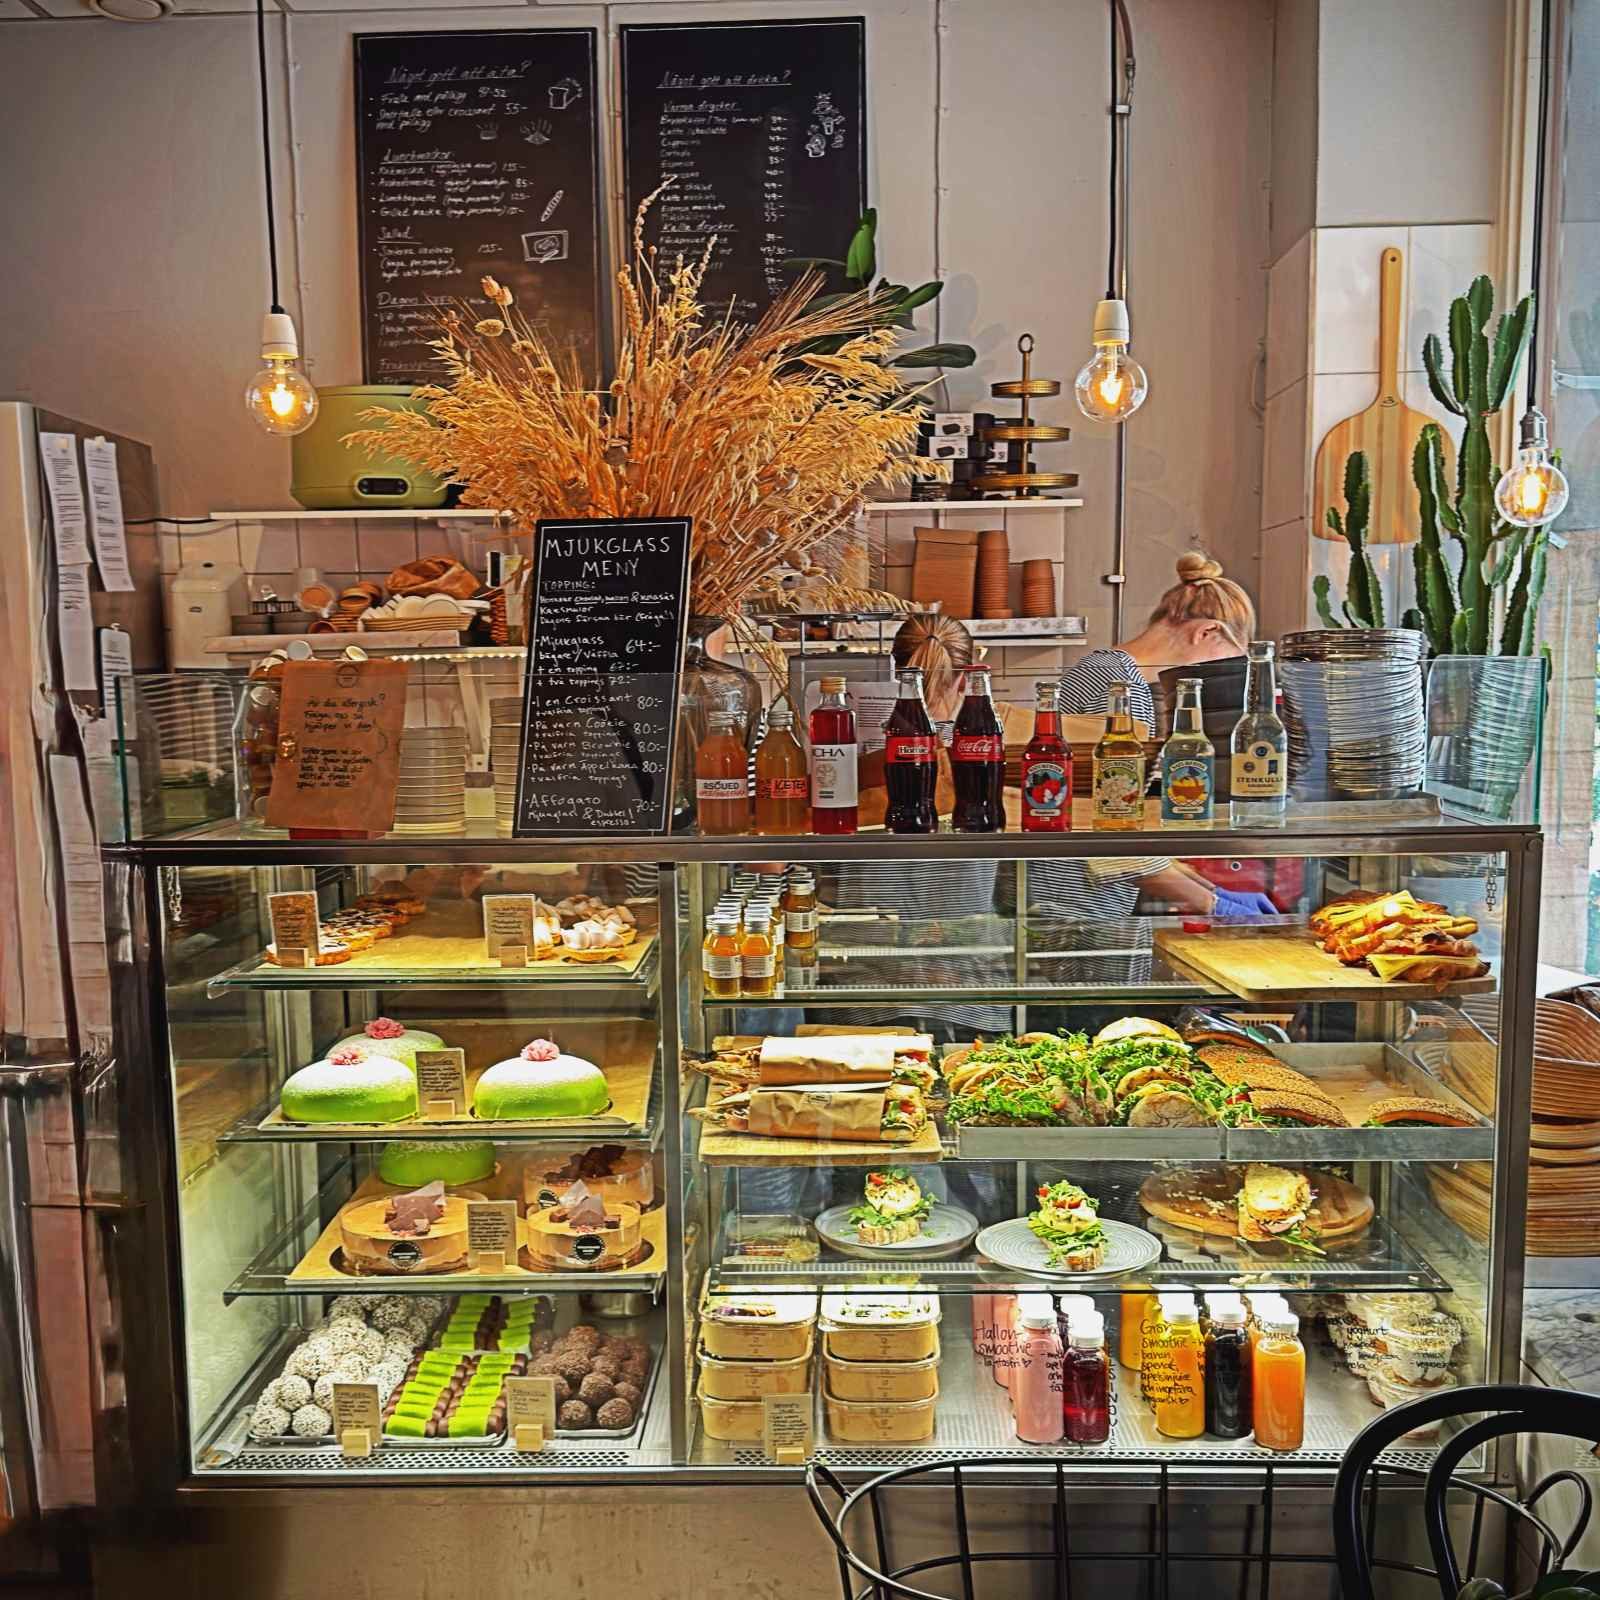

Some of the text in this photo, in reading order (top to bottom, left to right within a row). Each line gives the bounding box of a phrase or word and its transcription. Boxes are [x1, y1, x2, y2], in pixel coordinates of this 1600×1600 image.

[545, 536, 671, 559] MJUKGLASS
[581, 557, 640, 578] MENY
[543, 580, 596, 592] TOPPING:
[545, 698, 560, 707] en
[564, 692, 633, 705] Croissant
[636, 695, 664, 710] 80:-
[586, 716, 629, 730] Cookie
[633, 721, 665, 736] 80:-
[638, 740, 667, 753] 80:-
[957, 739, 994, 754] Coca-Cola
[641, 760, 666, 774] 80:-
[529, 793, 660, 814] Affogato 70:-
[582, 806, 592, 820] &
